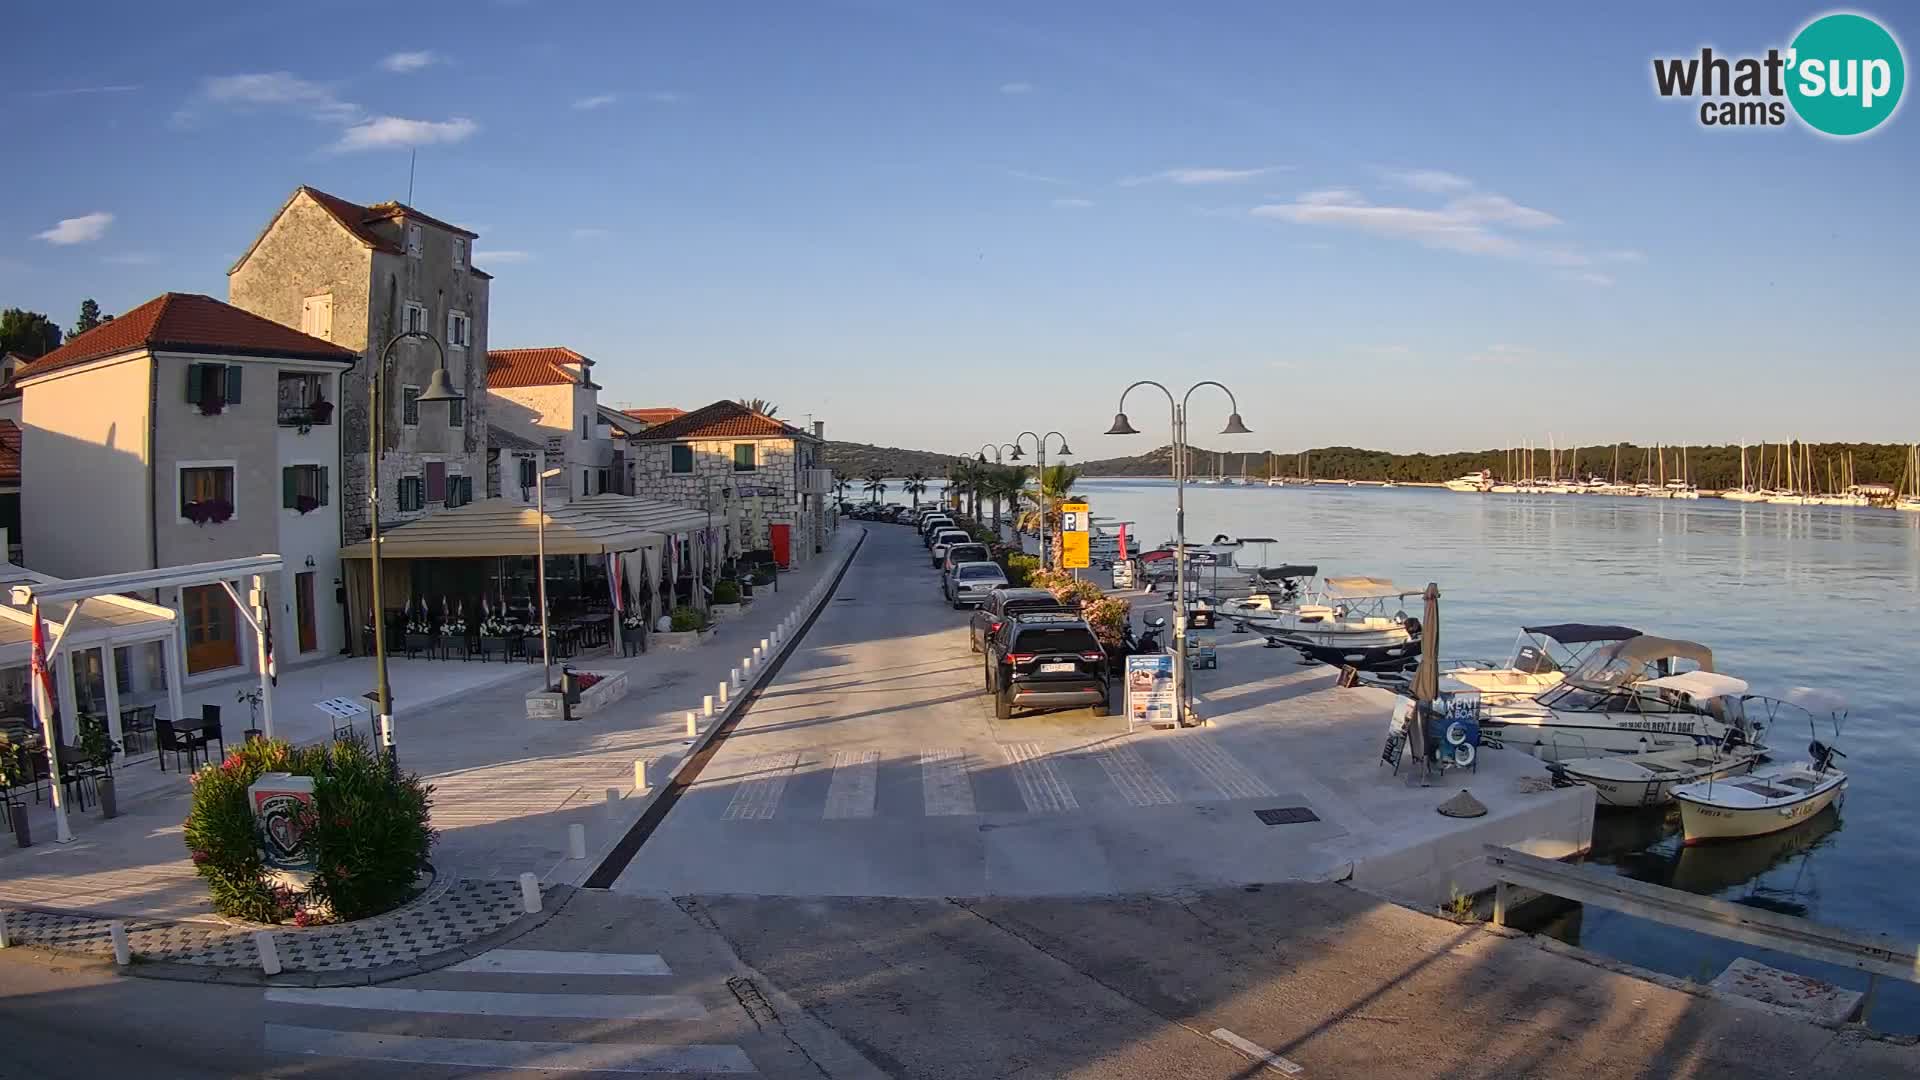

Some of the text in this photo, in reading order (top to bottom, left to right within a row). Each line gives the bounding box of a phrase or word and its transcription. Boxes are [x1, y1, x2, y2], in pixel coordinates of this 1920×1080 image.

[1446, 697, 1479, 710] RENT
[1446, 709, 1478, 719] A BOAT
[1651, 721, 1671, 732] RENT
[1672, 722, 1677, 732] A
[1678, 722, 1696, 733] BOAT
